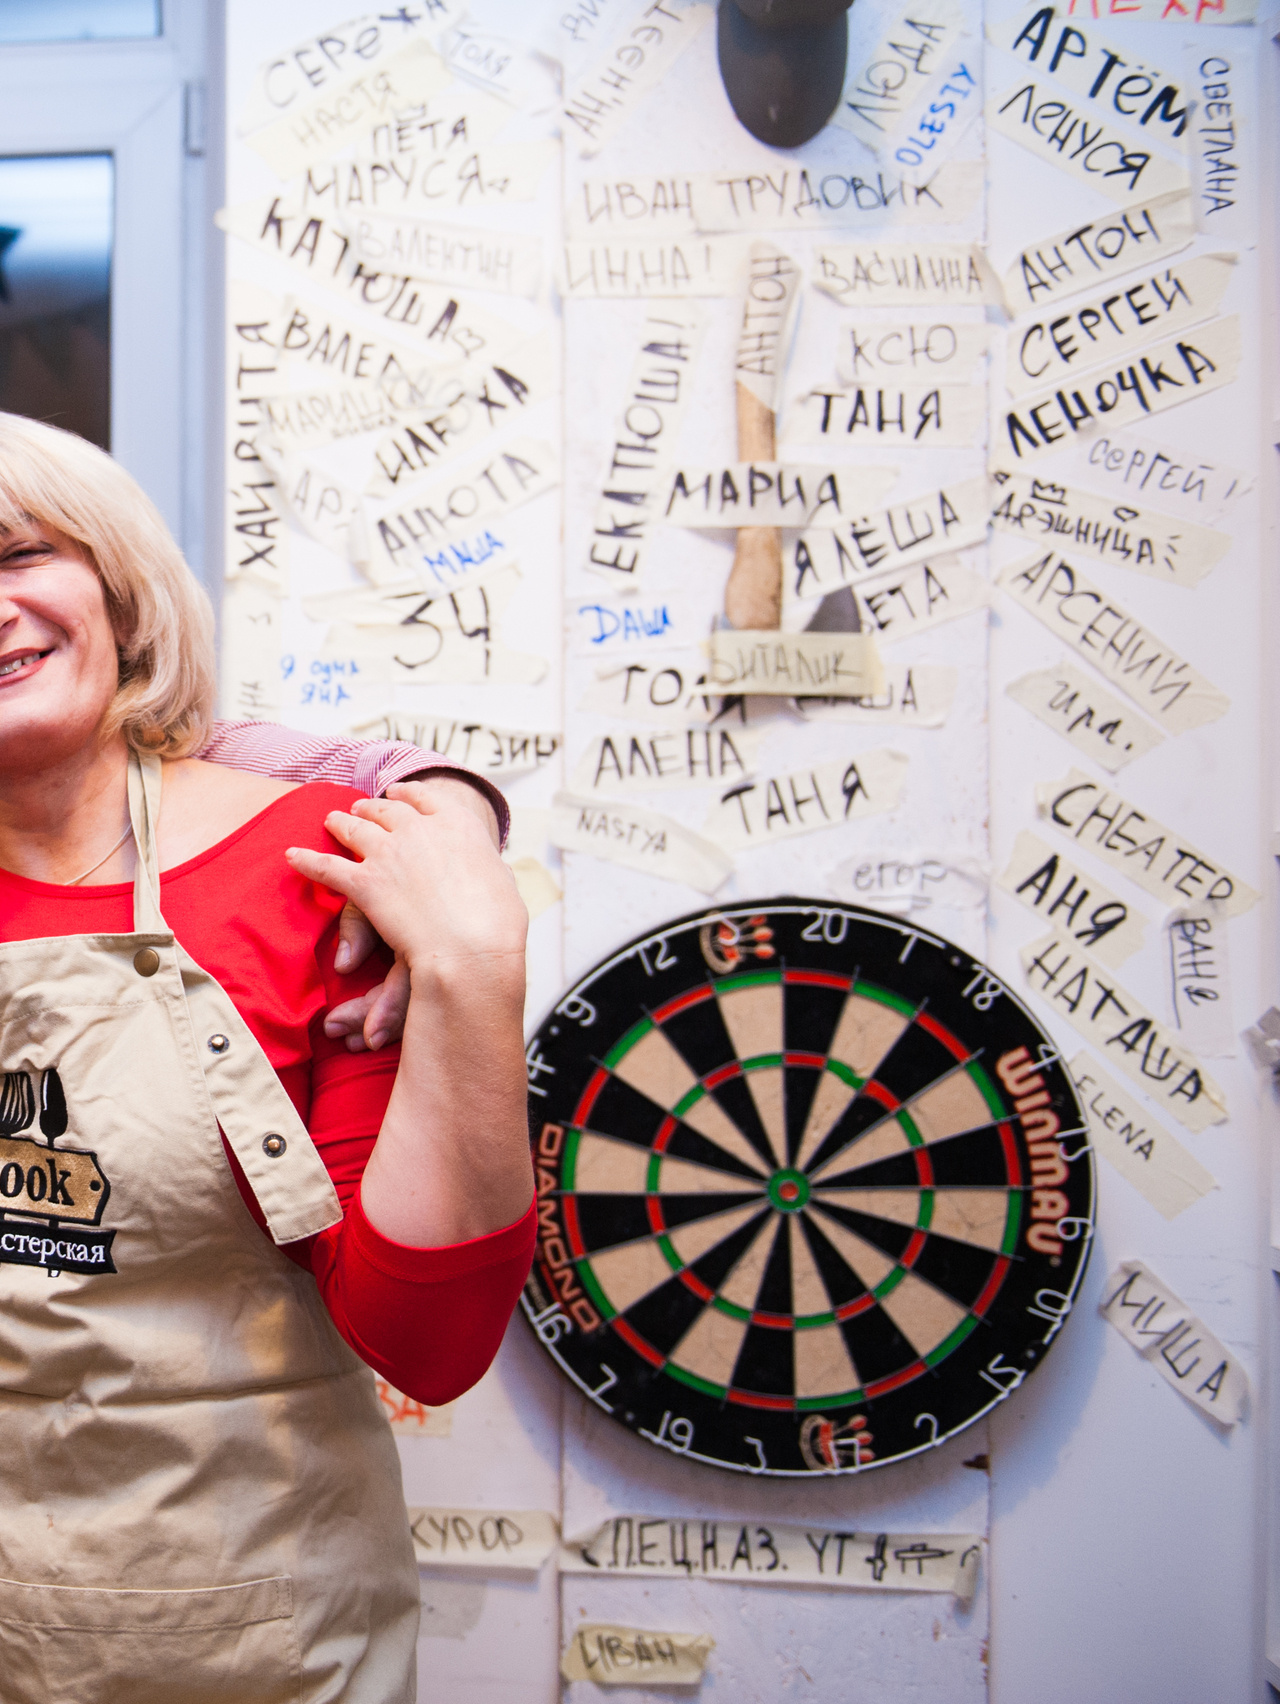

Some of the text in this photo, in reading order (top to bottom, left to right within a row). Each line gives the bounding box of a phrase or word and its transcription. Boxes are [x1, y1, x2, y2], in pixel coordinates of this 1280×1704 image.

[290, 71, 398, 147] НАСТЯ
[846, 19, 946, 132] ЛЮДА
[373, 115, 469, 155] ПЕТЯ
[1197, 57, 1240, 216] СВЕТЛАНА
[302, 153, 484, 209] МАРУСЯ
[583, 179, 694, 223] ИВАН
[260, 197, 460, 342] КАТЮША
[356, 220, 514, 292] ВАЛЕНТИН
[1020, 209, 1161, 303] АНТОН
[736, 255, 795, 376] АНТОН
[851, 324, 958, 375] КСЮ
[1020, 268, 1192, 378] СЕРГЕЙ
[808, 388, 942, 440] ТАНЯ
[1006, 341, 1218, 458] ЛЕНОЧКА
[665, 465, 842, 528] МАРИЯ
[1011, 551, 1192, 712] АРСЕНИЙ
[593, 727, 746, 789] АЛЕНА
[577, 808, 668, 853] NASTYA
[720, 760, 871, 836] ТАНЯ
[801, 909, 848, 945] 20
[1016, 852, 1128, 948] АНЯ
[634, 937, 678, 977] 12
[962, 962, 1004, 1012] 18
[1026, 940, 1204, 1104] НАТАША
[1075, 1074, 1155, 1161] ELENA
[537, 1122, 600, 1333] DIAMOND
[532, 1301, 573, 1345] 16
[1104, 1270, 1229, 1402] МИША
[654, 1410, 695, 1453] 19
[578, 1631, 677, 1674] ИВАН
